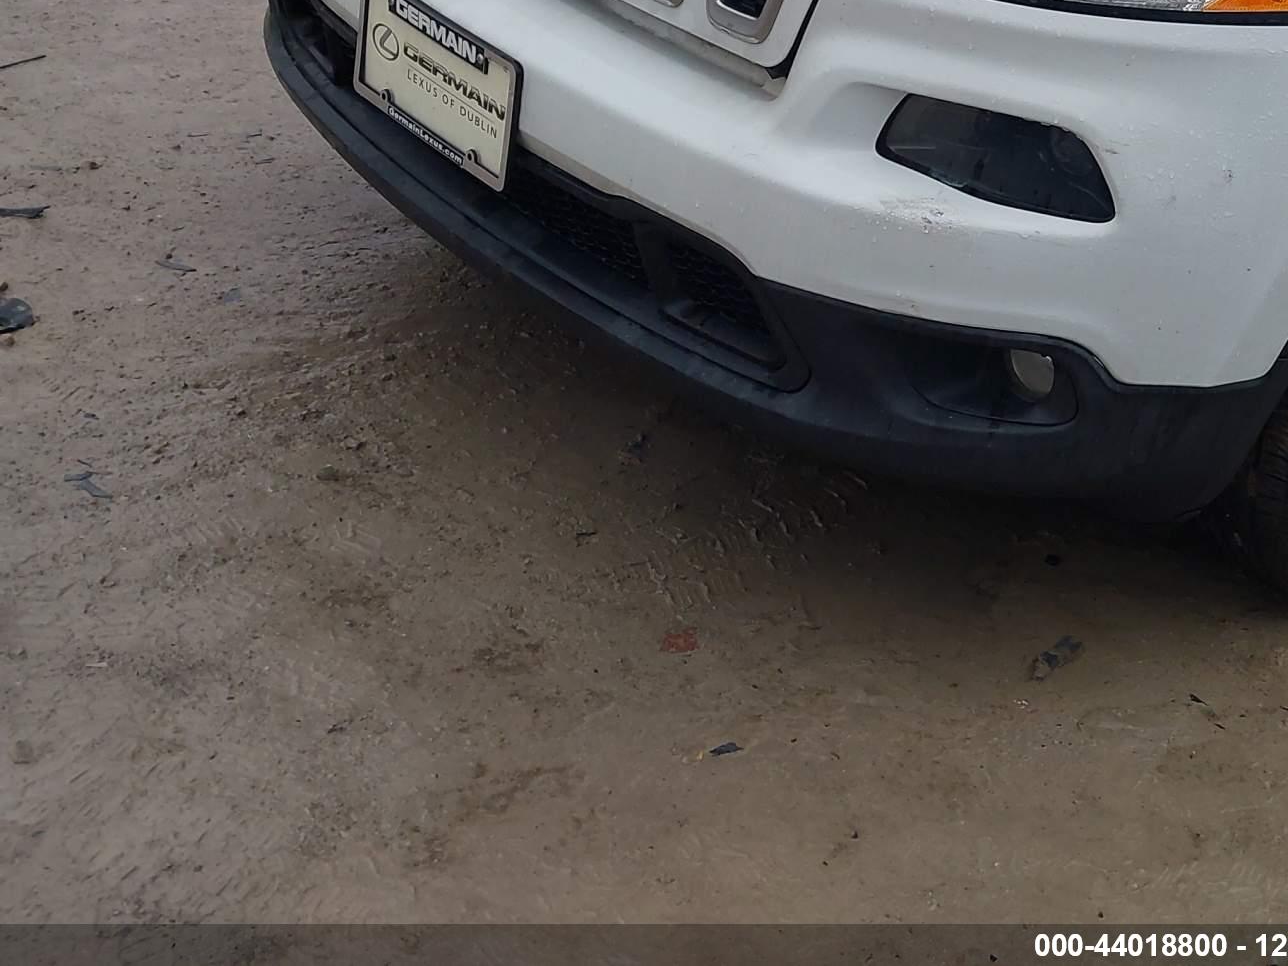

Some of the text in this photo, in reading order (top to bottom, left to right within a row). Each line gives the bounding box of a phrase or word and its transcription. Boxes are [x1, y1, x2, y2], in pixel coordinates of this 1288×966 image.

[403, 41, 506, 122] GERMAIN
[407, 68, 497, 139] LEXUS OF DUBLIN
